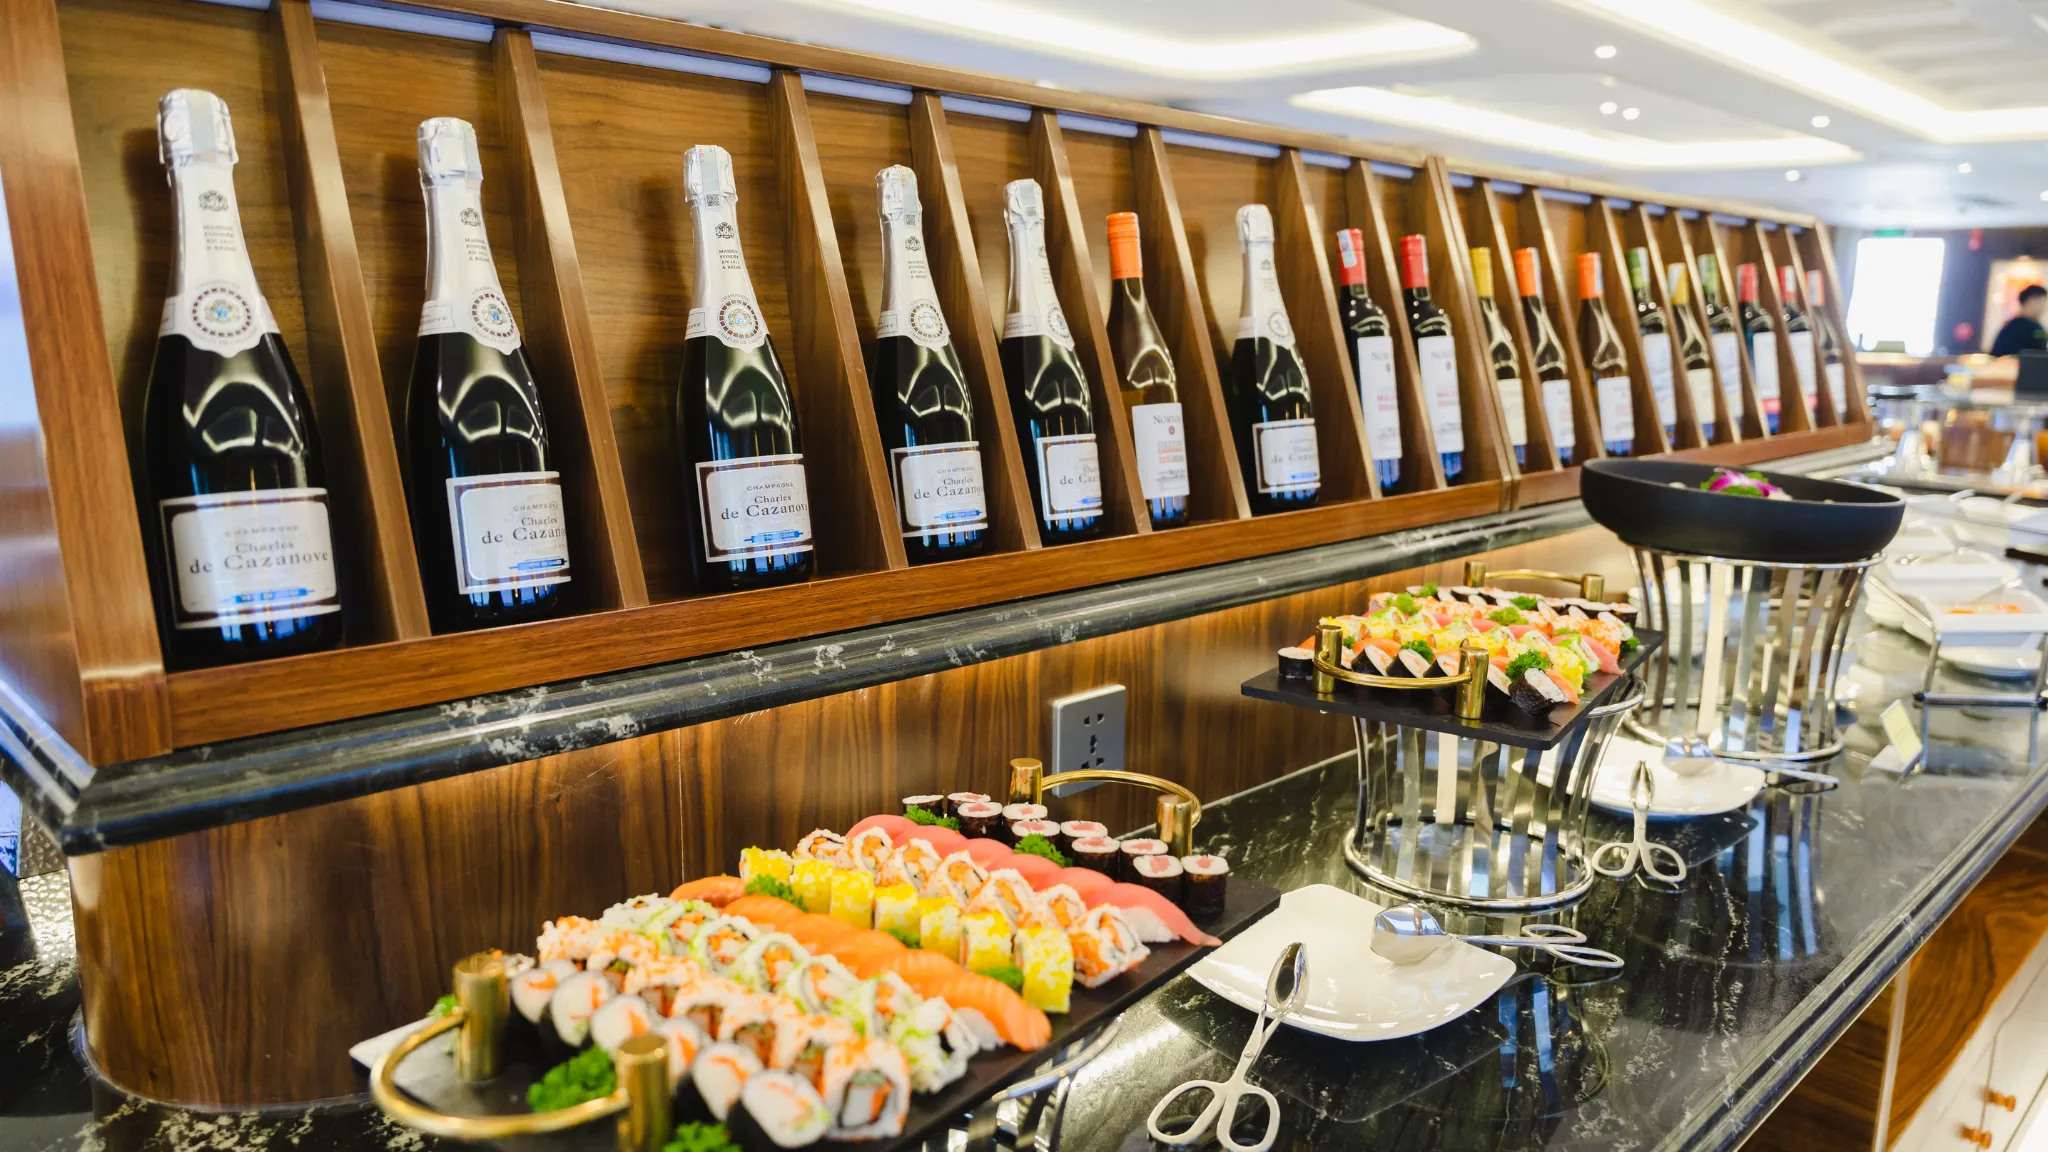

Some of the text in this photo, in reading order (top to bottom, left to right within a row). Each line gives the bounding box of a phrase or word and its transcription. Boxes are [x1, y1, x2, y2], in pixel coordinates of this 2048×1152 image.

[943, 477, 973, 486] Charles
[1060, 475, 1074, 485] de
[747, 482, 794, 491] CHAMPAGNE
[754, 494, 792, 504] Charles
[913, 489, 930, 500] de
[721, 508, 739, 520] de
[521, 516, 558, 526] Charles
[481, 531, 503, 544] de
[235, 540, 295, 554] Charles
[189, 550, 329, 574] de Cazanove
